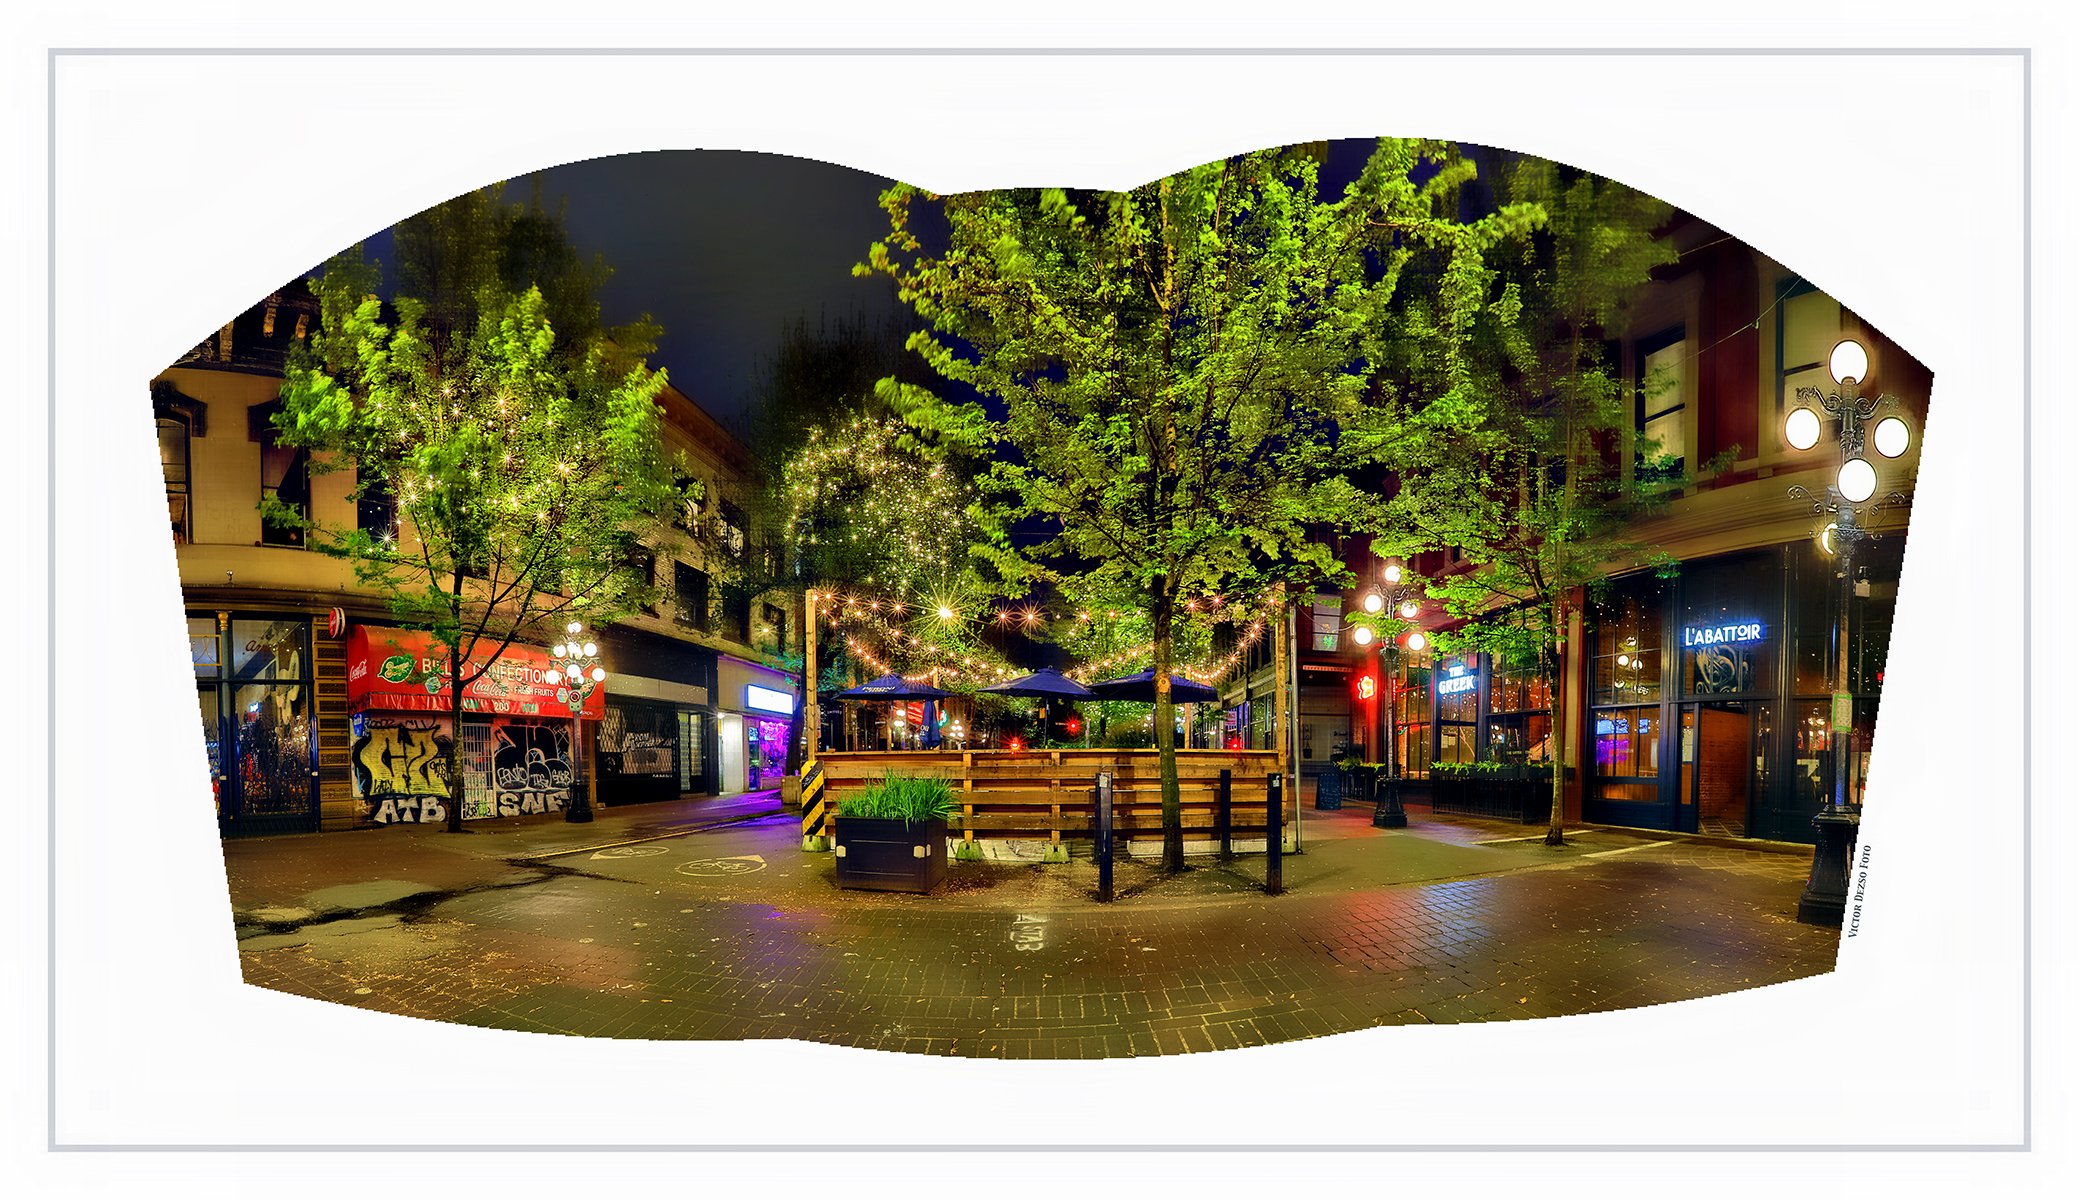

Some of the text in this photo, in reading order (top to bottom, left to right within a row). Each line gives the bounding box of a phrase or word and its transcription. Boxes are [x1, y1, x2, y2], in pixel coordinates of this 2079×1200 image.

[1685, 623, 1761, 646] L'ABATTOIR
[473, 661, 569, 686] CONFECTIONRY
[1449, 665, 1465, 677] THE
[534, 687, 554, 697] FRUITS
[1438, 674, 1475, 695] GREEK
[494, 701, 510, 712] 200
[374, 796, 446, 823] ATB
[499, 792, 571, 817] SNF
